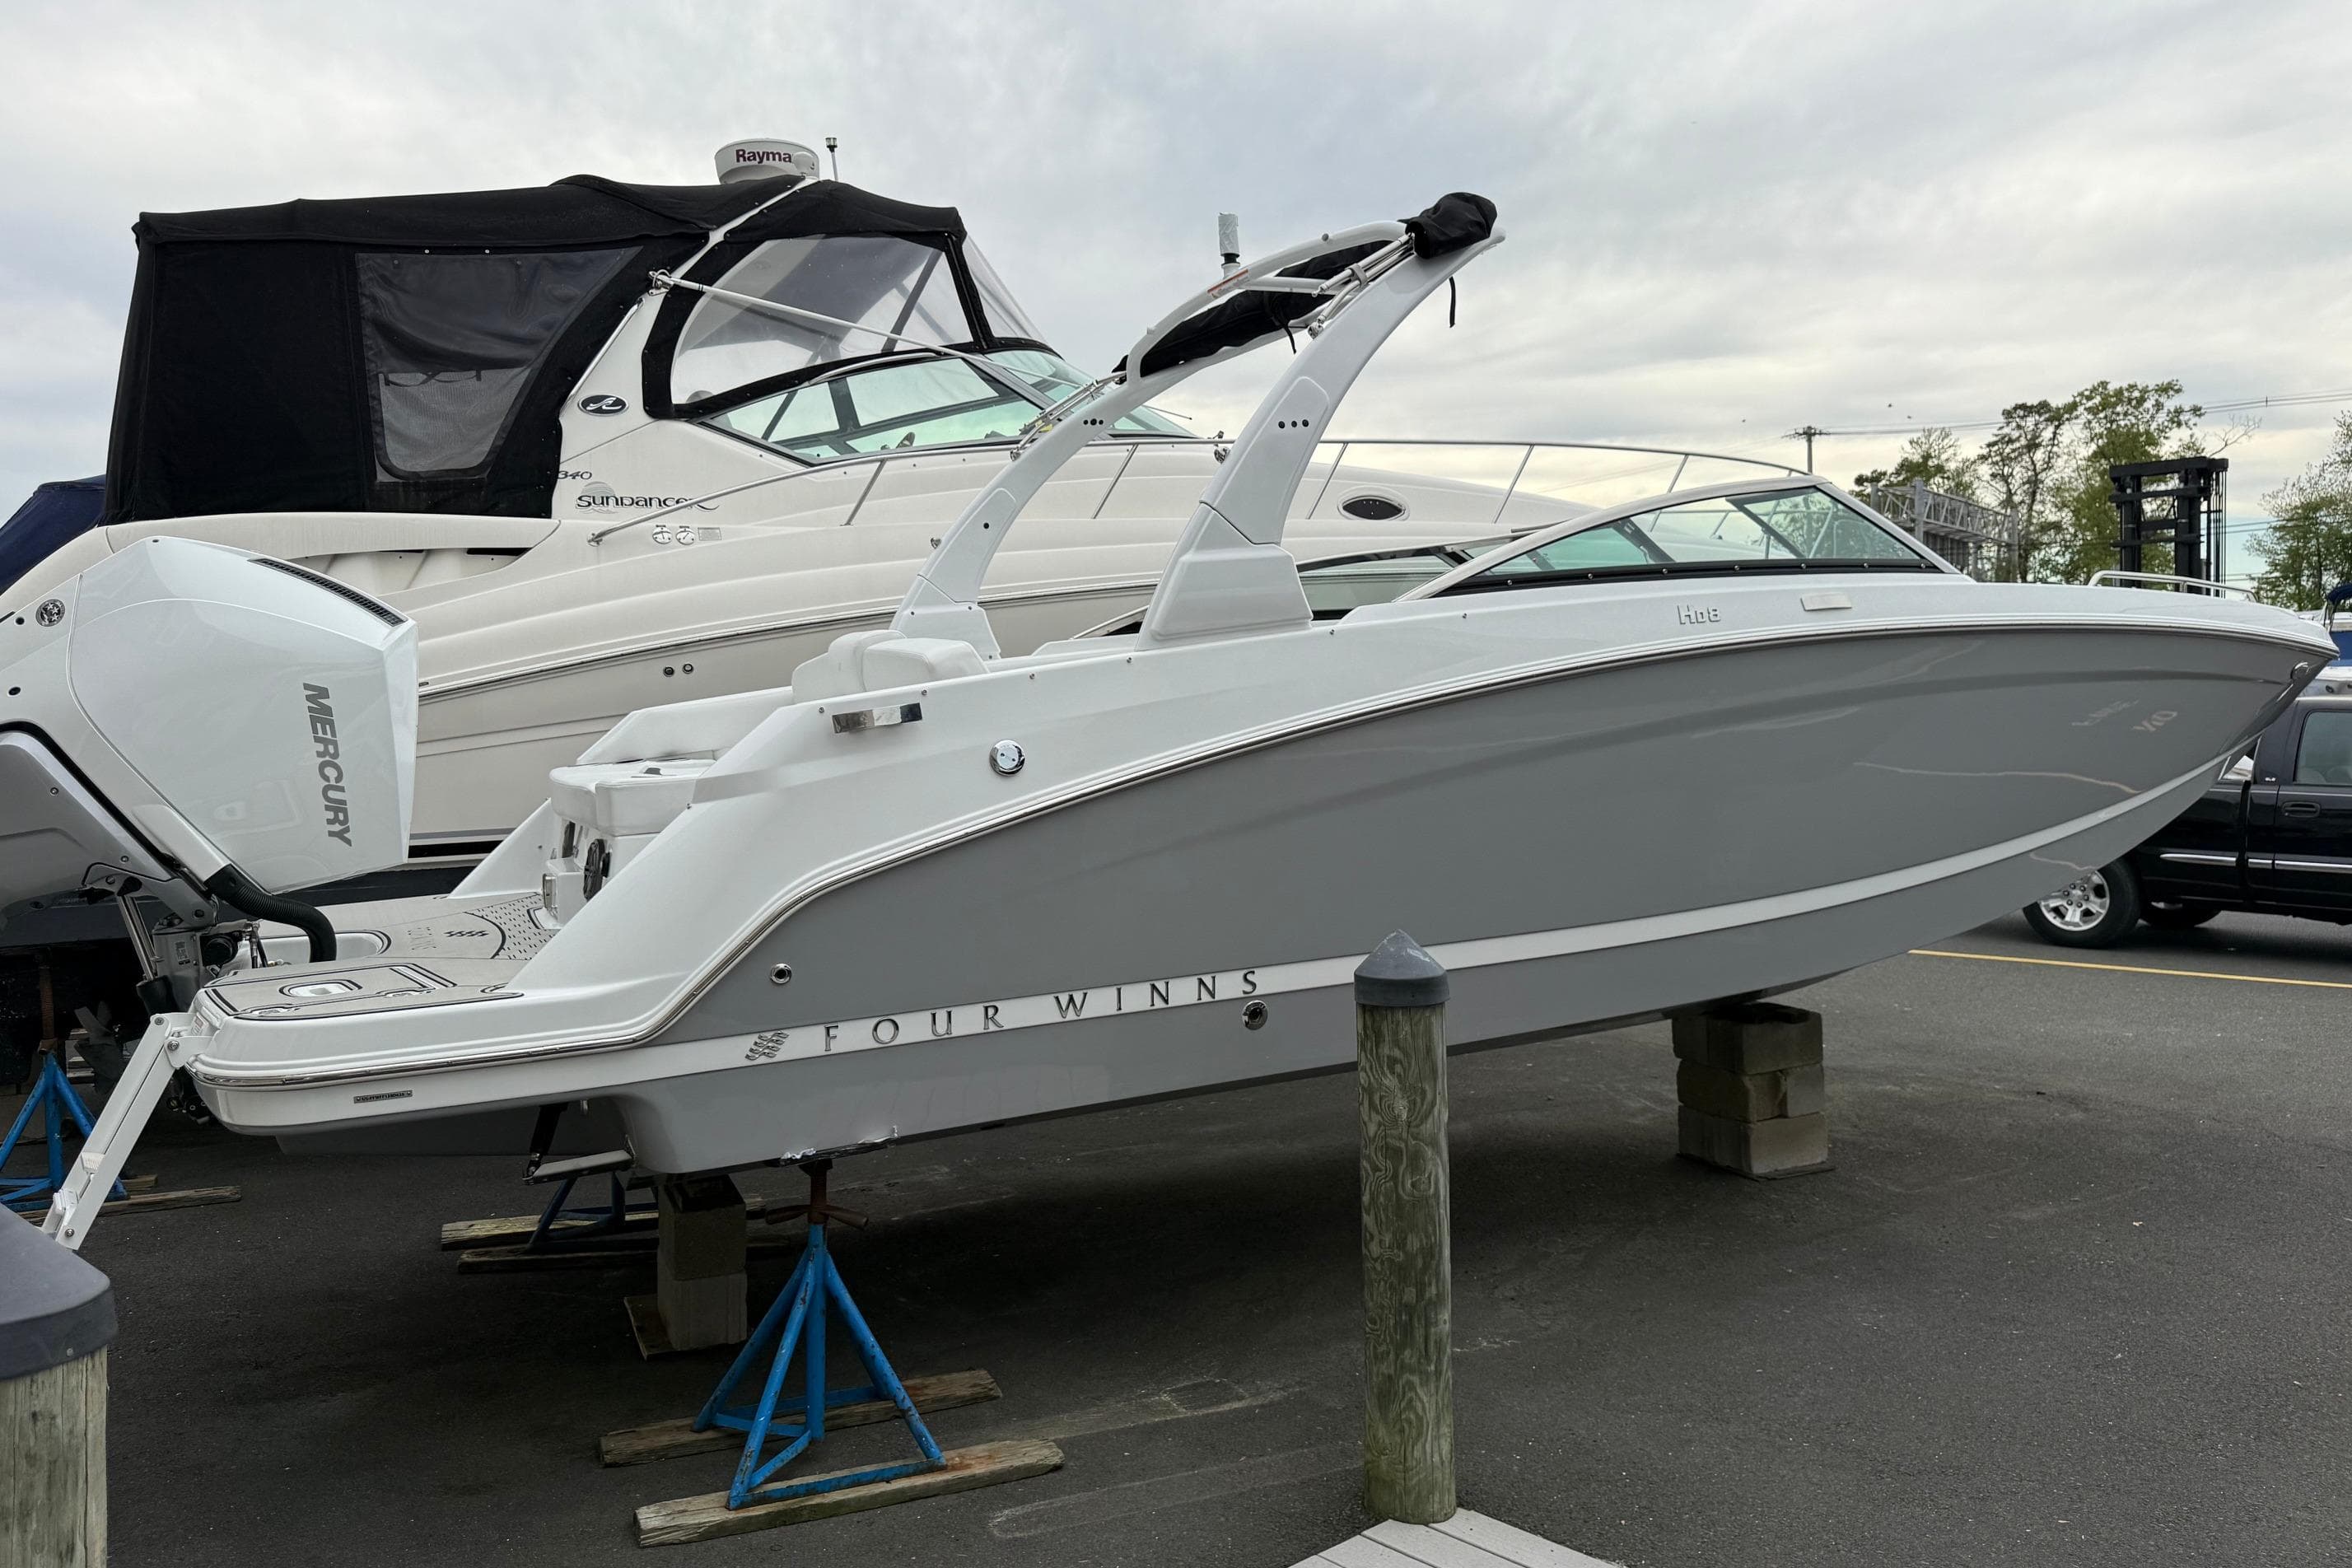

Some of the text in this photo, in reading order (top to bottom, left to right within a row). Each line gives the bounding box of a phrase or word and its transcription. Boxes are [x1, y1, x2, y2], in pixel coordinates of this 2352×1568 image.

[735, 148, 803, 167] Rayma
[558, 470, 593, 480] 340
[302, 682, 352, 847] MERCURY
[824, 969, 1258, 1052] FOUR WINNS
